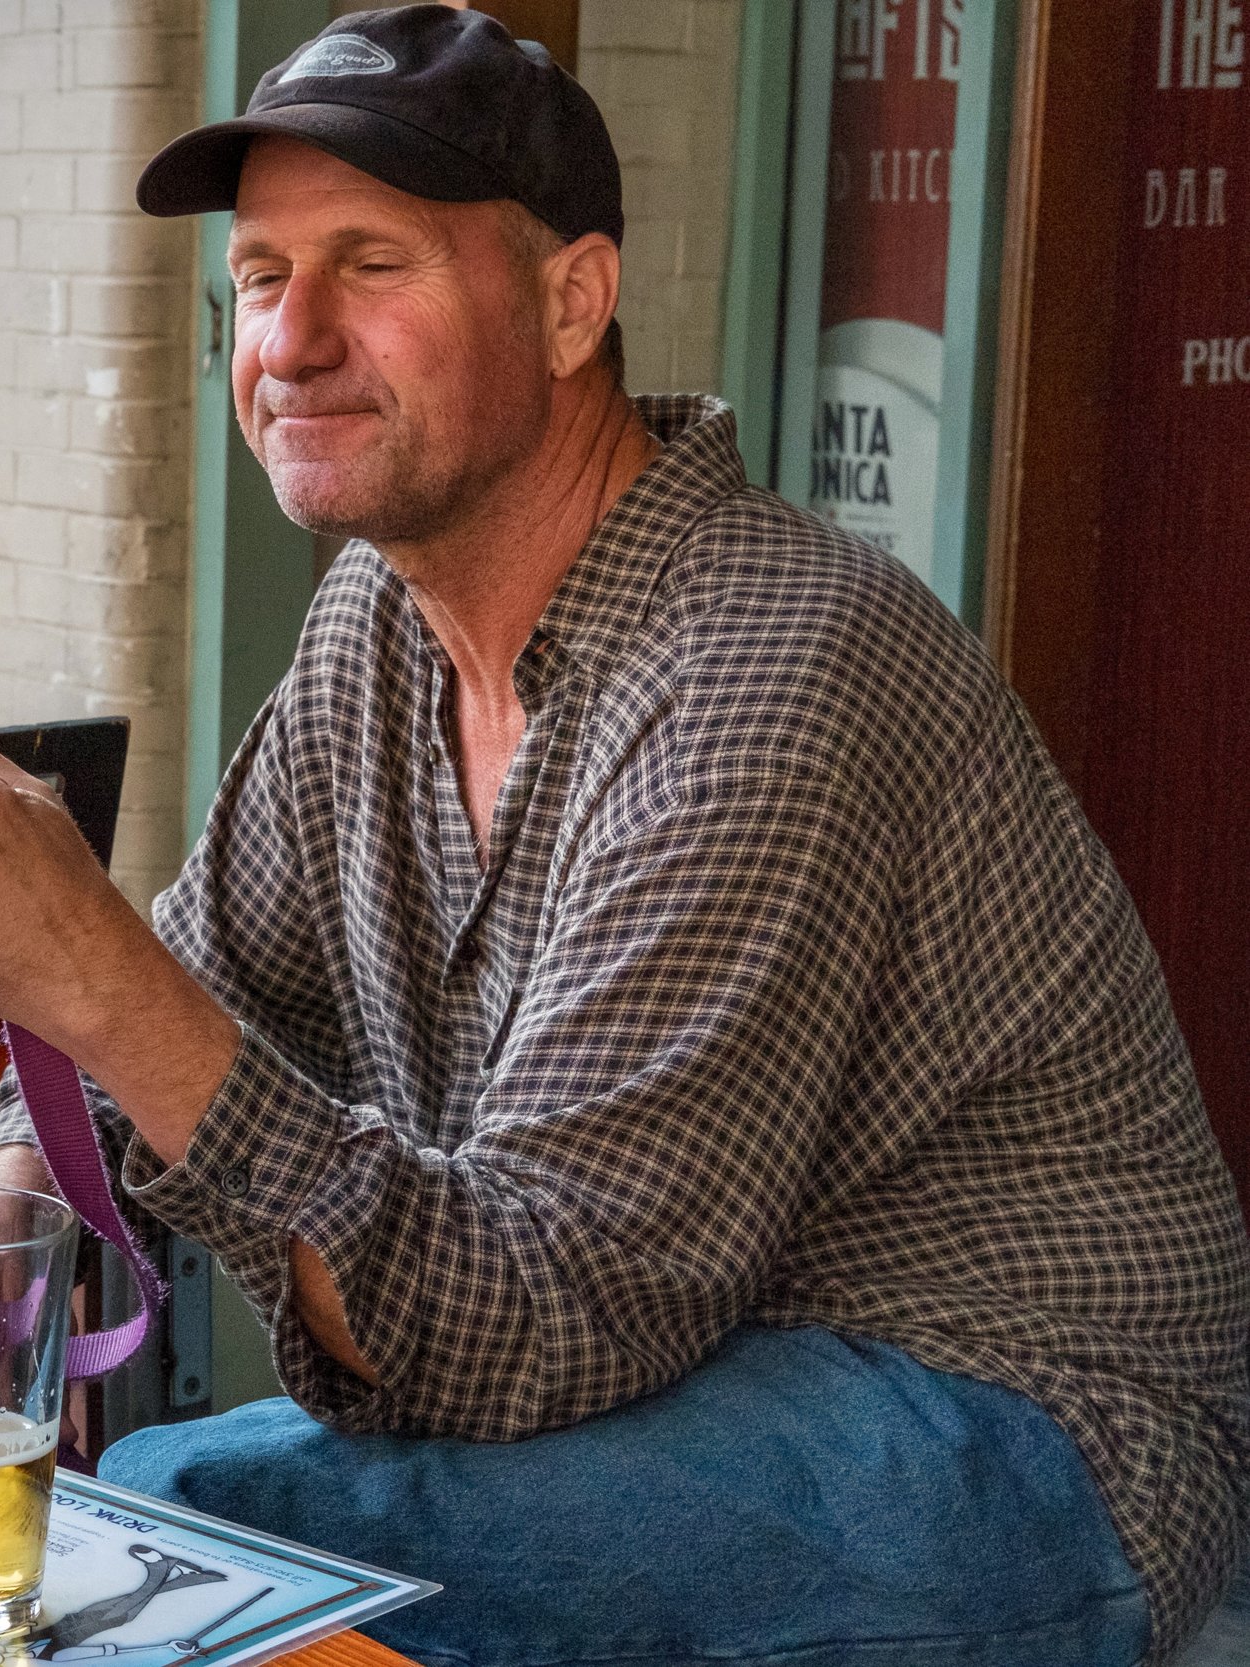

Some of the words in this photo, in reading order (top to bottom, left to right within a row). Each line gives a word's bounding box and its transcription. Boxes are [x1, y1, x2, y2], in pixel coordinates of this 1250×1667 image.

[1145, 167, 1227, 228] BAR
[87, 1508, 159, 1533] DRINK
[230, 1561, 287, 1581] reservations
